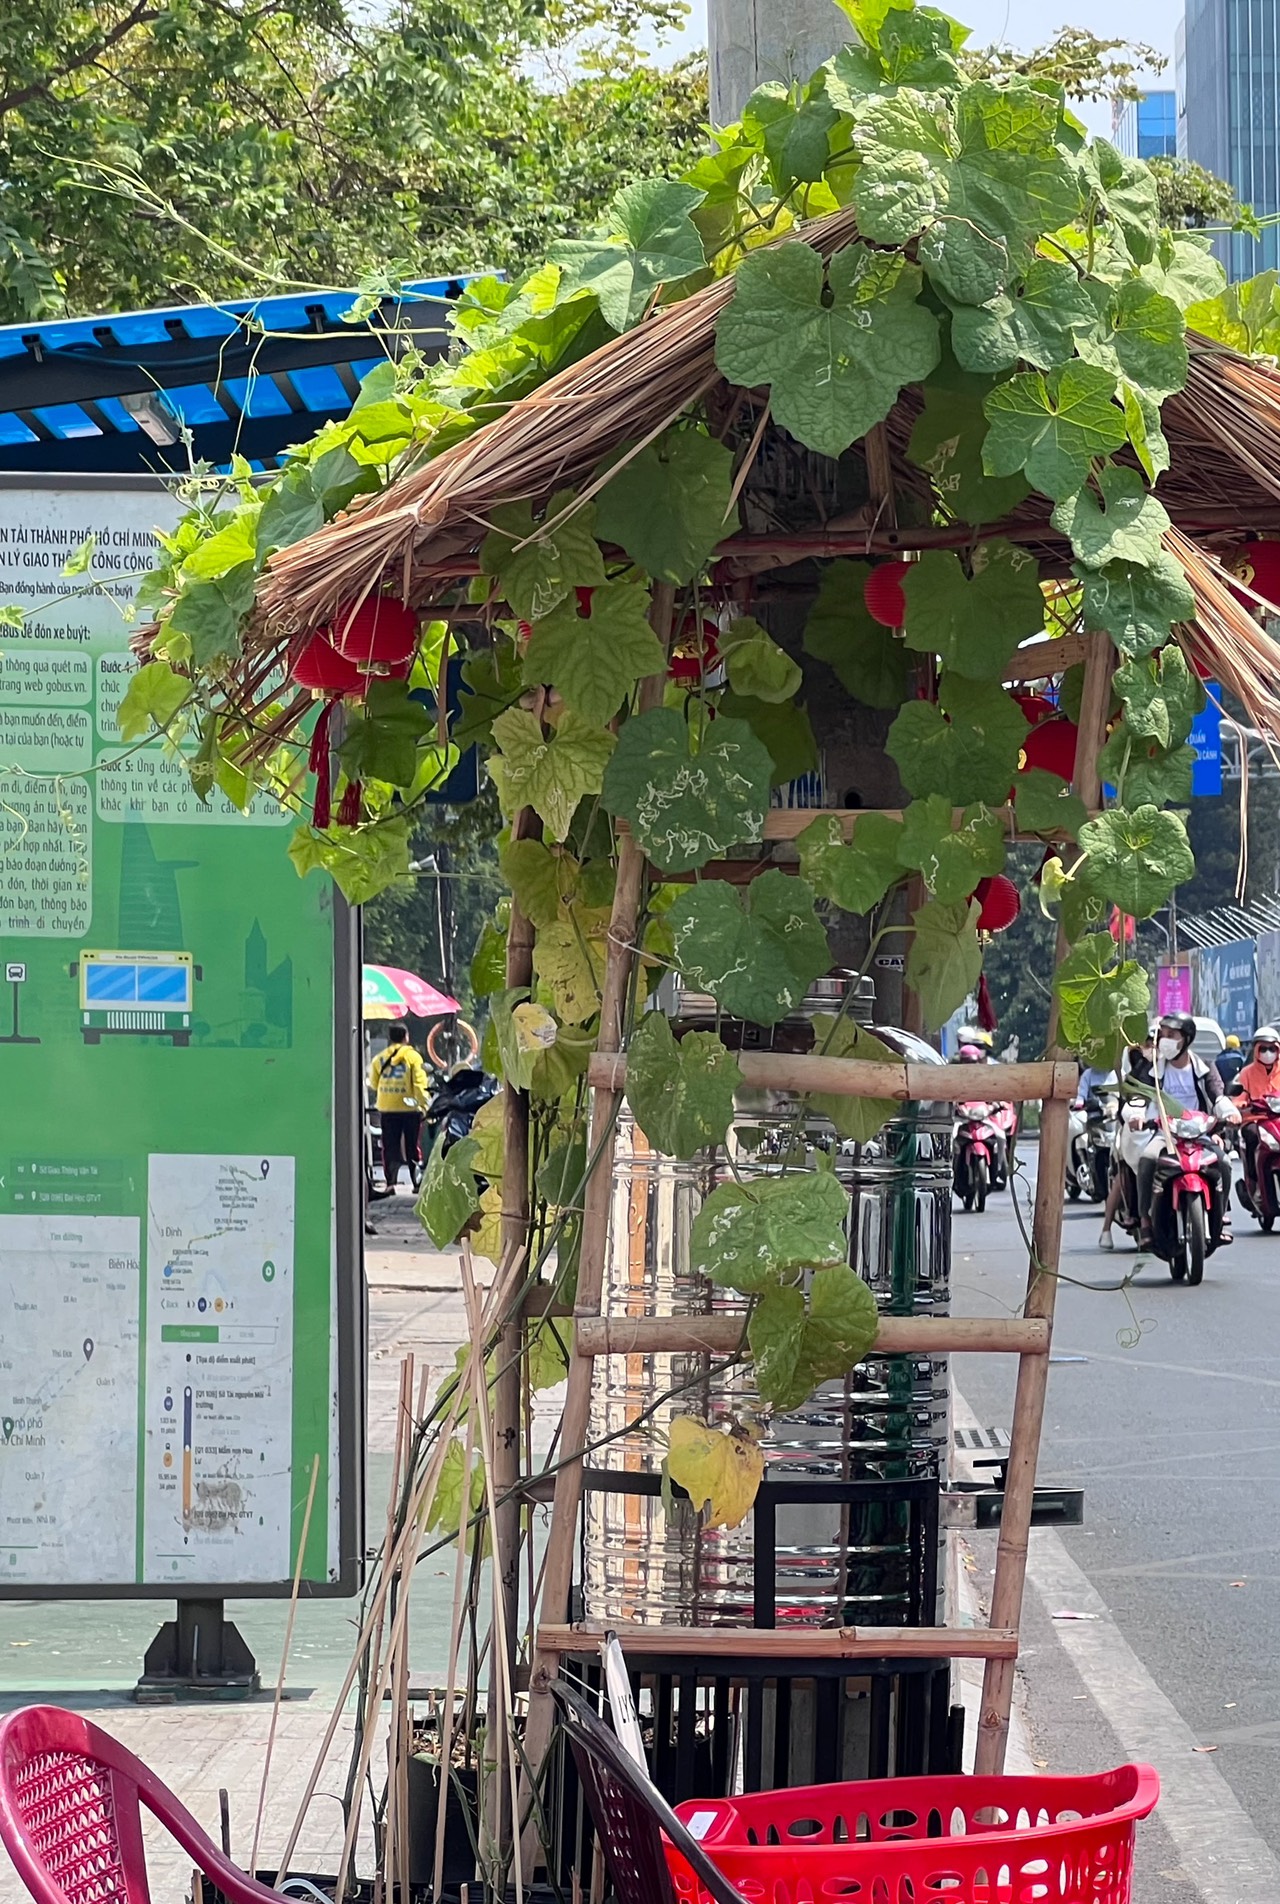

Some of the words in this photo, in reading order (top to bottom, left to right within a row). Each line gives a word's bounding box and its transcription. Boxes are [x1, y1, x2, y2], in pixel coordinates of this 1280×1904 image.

[31, 525, 67, 544] THÀNH
[113, 526, 130, 546] CHÍ
[23, 552, 49, 567] GIAO
[92, 551, 120, 569] CÔNG
[124, 552, 152, 572] CỘNG
[36, 582, 56, 595] hành
[57, 583, 70, 595] của
[115, 584, 133, 599] buýt
[35, 624, 51, 639] đón
[54, 627, 64, 639] xe
[67, 625, 91, 644] buýt:
[6, 658, 30, 675] thông
[33, 660, 49, 675] qua
[52, 659, 71, 675] quét
[101, 660, 122, 673] Bước
[24, 678, 43, 691] web
[46, 678, 87, 695] gobus.vn.
[101, 679, 120, 693] chức
[5, 712, 20, 727] bạn
[21, 712, 45, 726] muốn
[47, 713, 65, 728] đến,
[6, 733, 16, 746] tại
[18, 733, 32, 745] của
[34, 733, 49, 747] bạn
[51, 733, 73, 749] (hoặc
[125, 761, 133, 773] 5:
[137, 758, 154, 776] Ứng
[159, 760, 182, 776] dụng
[24, 780, 47, 794] điểm
[70, 783, 88, 798] ứng
[101, 780, 127, 795] thông
[131, 780, 143, 792] tin
[147, 779, 158, 792] về
[162, 781, 177, 793] các
[34, 800, 44, 813] án
[76, 804, 87, 814] xe
[101, 798, 121, 811] khác
[130, 798, 144, 811] khi
[152, 798, 169, 813] bạn
[177, 799, 188, 812] có
[28, 820, 45, 834] Bạn
[47, 820, 63, 835] hãy
[23, 841, 41, 854] hợp
[6, 858, 22, 871] báo
[25, 858, 47, 872] đoạn
[49, 858, 77, 875] đường
[8, 878, 27, 891] đón,
[31, 878, 48, 890] thời
[53, 879, 72, 894] gian
[18, 897, 37, 911] bạn,
[41, 897, 67, 913] thông
[70, 898, 87, 910] báo
[8, 916, 29, 929] trình
[25, 1434, 46, 1447] Minh
